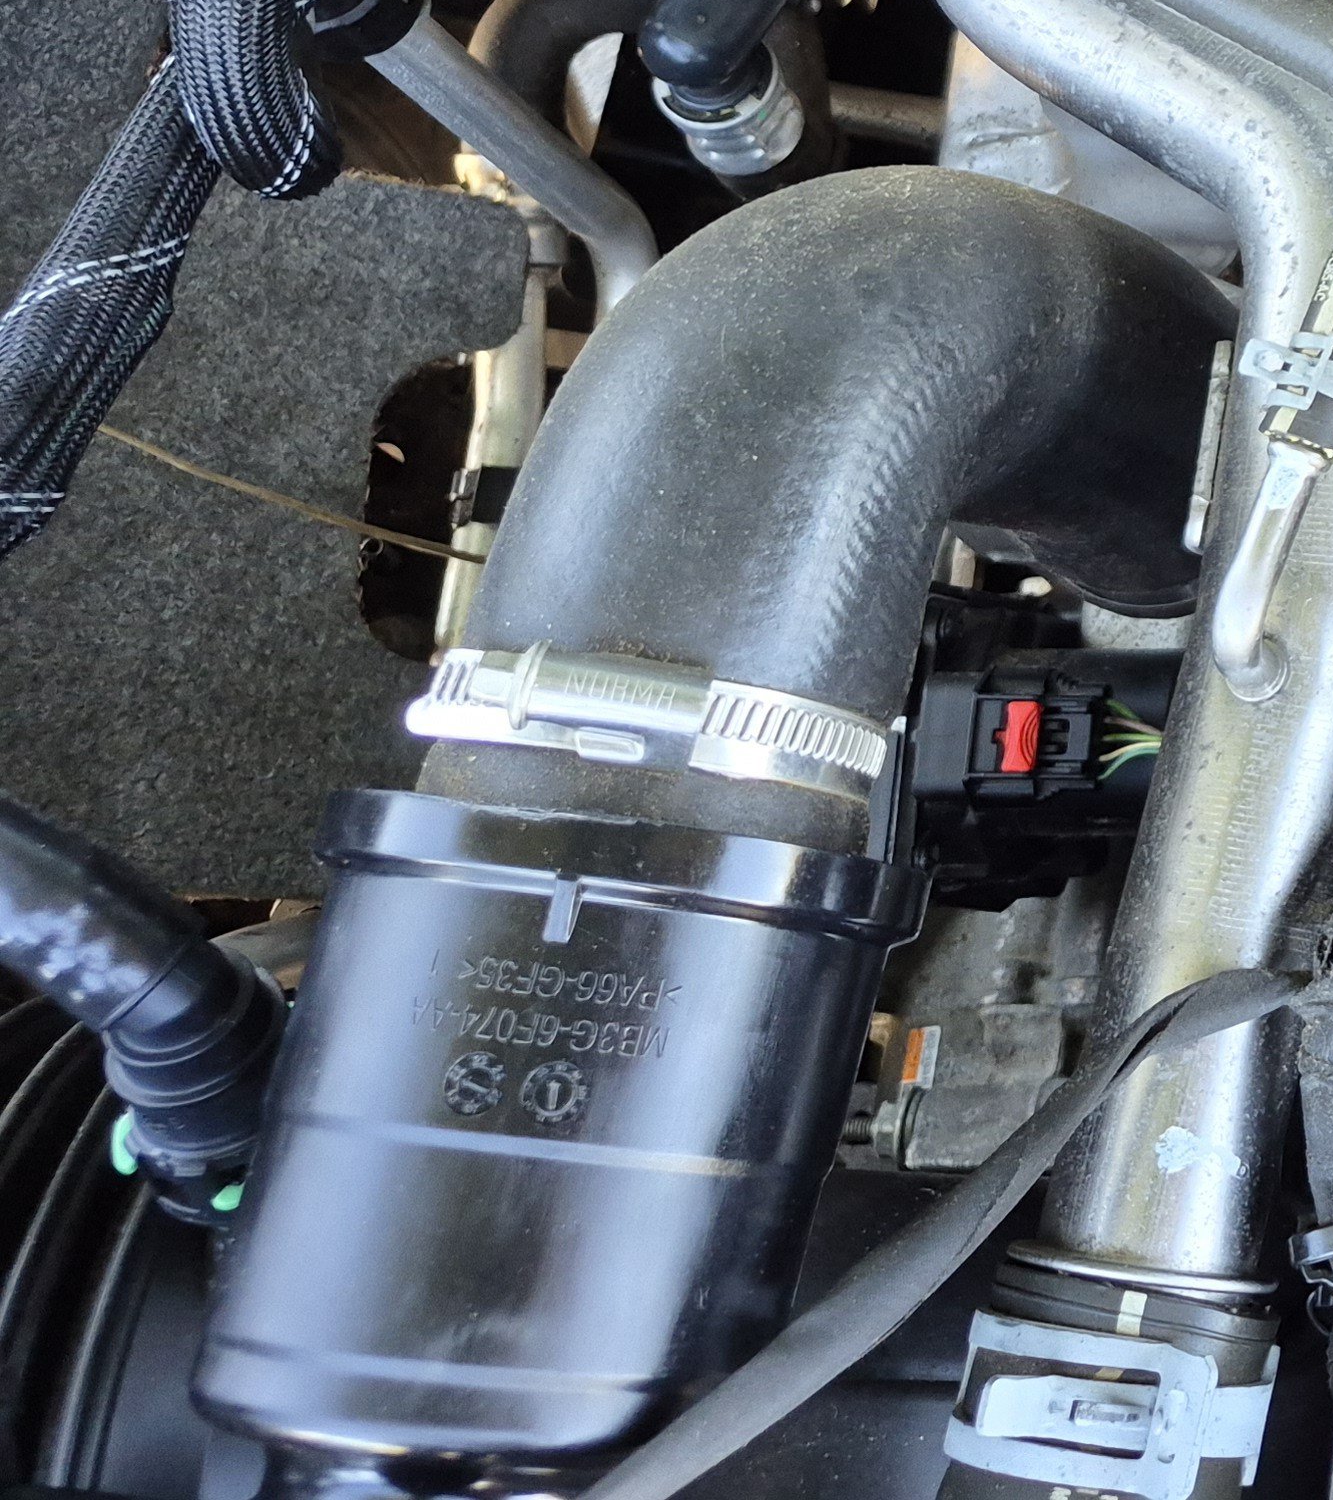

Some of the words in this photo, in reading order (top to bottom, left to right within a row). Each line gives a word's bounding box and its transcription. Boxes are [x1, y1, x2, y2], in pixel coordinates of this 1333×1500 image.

[563, 666, 676, 712] NORMA
[457, 955, 683, 1011] >PA66-GF35<
[411, 996, 672, 1059] MB3G-6F074-AA
